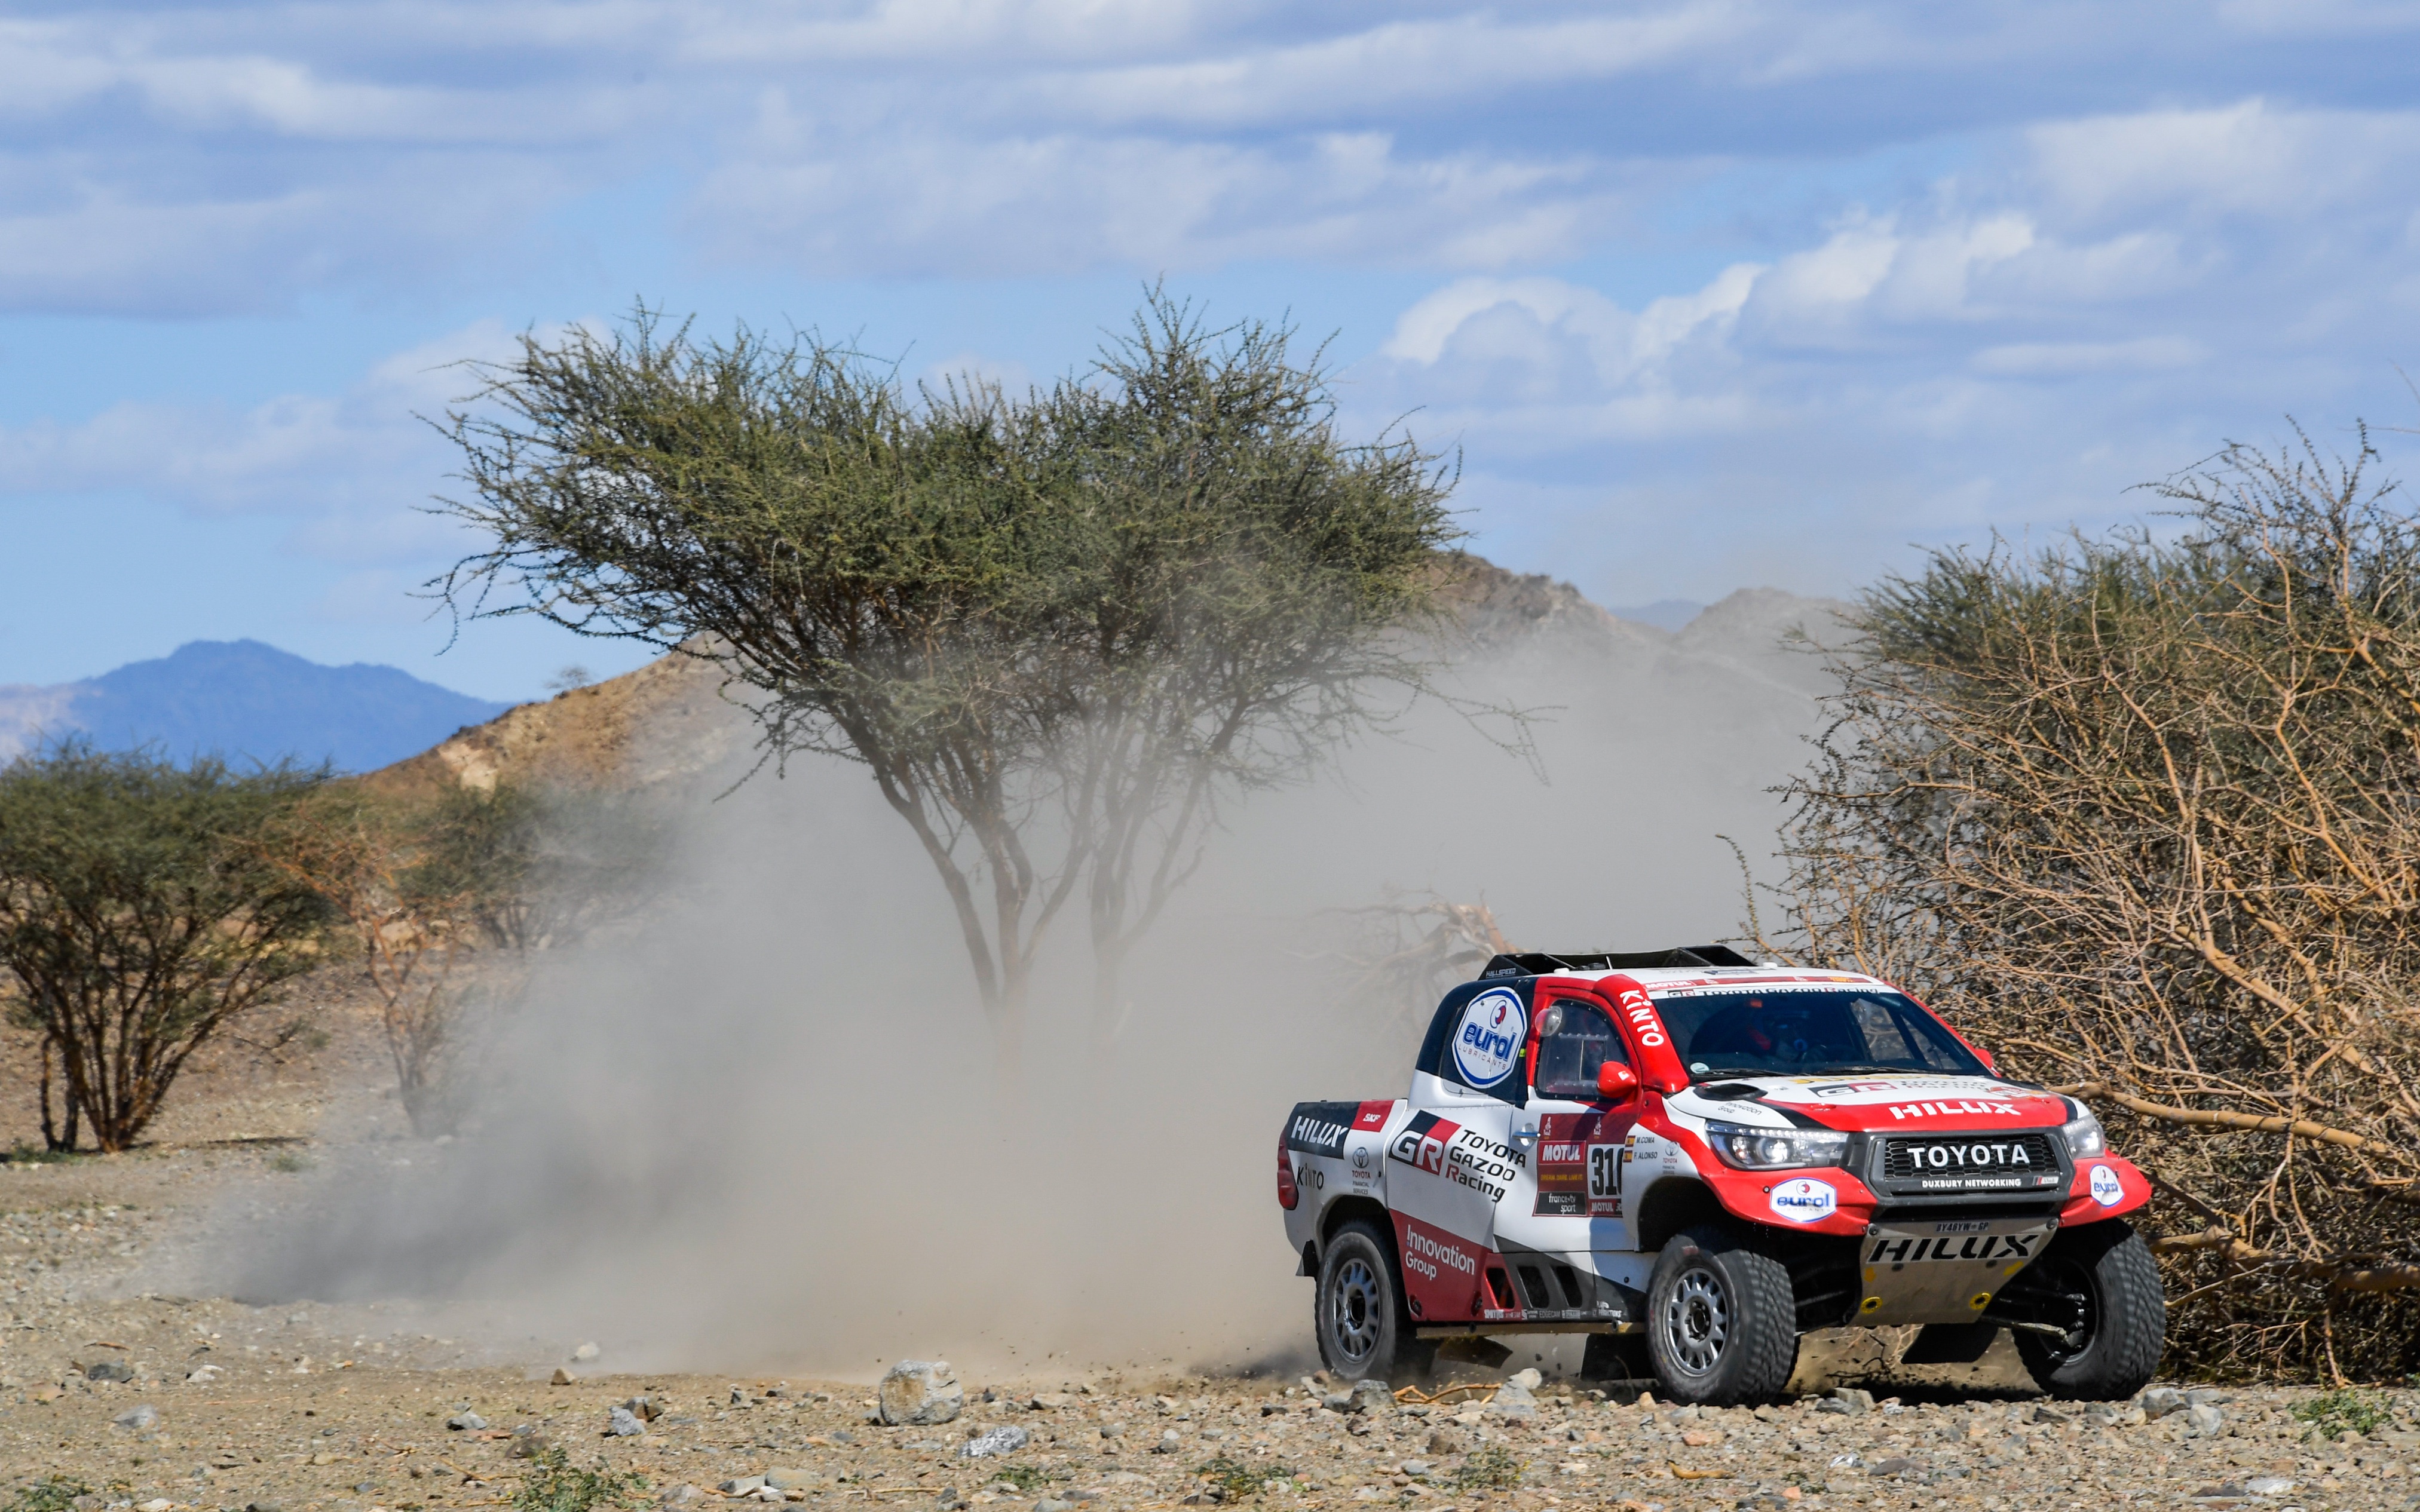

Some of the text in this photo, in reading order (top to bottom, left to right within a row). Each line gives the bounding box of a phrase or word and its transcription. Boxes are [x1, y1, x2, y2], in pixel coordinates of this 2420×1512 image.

[1485, 968, 1516, 977] HALLSPEED
[1646, 980, 1692, 989] MOTUL
[1463, 1022, 1517, 1062] eurol
[1458, 1044, 1506, 1070] LUBRICANTS
[1813, 1082, 1897, 1097] GR
[1362, 1113, 1381, 1123] SKF
[1889, 1102, 2021, 1120] HILUX
[1291, 1115, 1349, 1148] HILUX
[1390, 1130, 1444, 1173] GR
[1460, 1129, 1527, 1168] TOYOTA
[1542, 1144, 1580, 1161] MOTUL
[1907, 1144, 2030, 1168] TOYOTA
[1449, 1146, 1516, 1181] GAZOO
[1352, 1170, 1371, 1179] TOYOTA
[1445, 1164, 1506, 1203] Racing
[1922, 1179, 2022, 1188] DUXBURY NETWORKING
[1560, 1204, 1576, 1214] sport
[1591, 1202, 1614, 1212] MOTUL
[1777, 1193, 1830, 1208] eurol
[1407, 1224, 1475, 1275] Innovation
[1867, 1234, 2039, 1262] HILUX
[1405, 1251, 1437, 1281] Group
